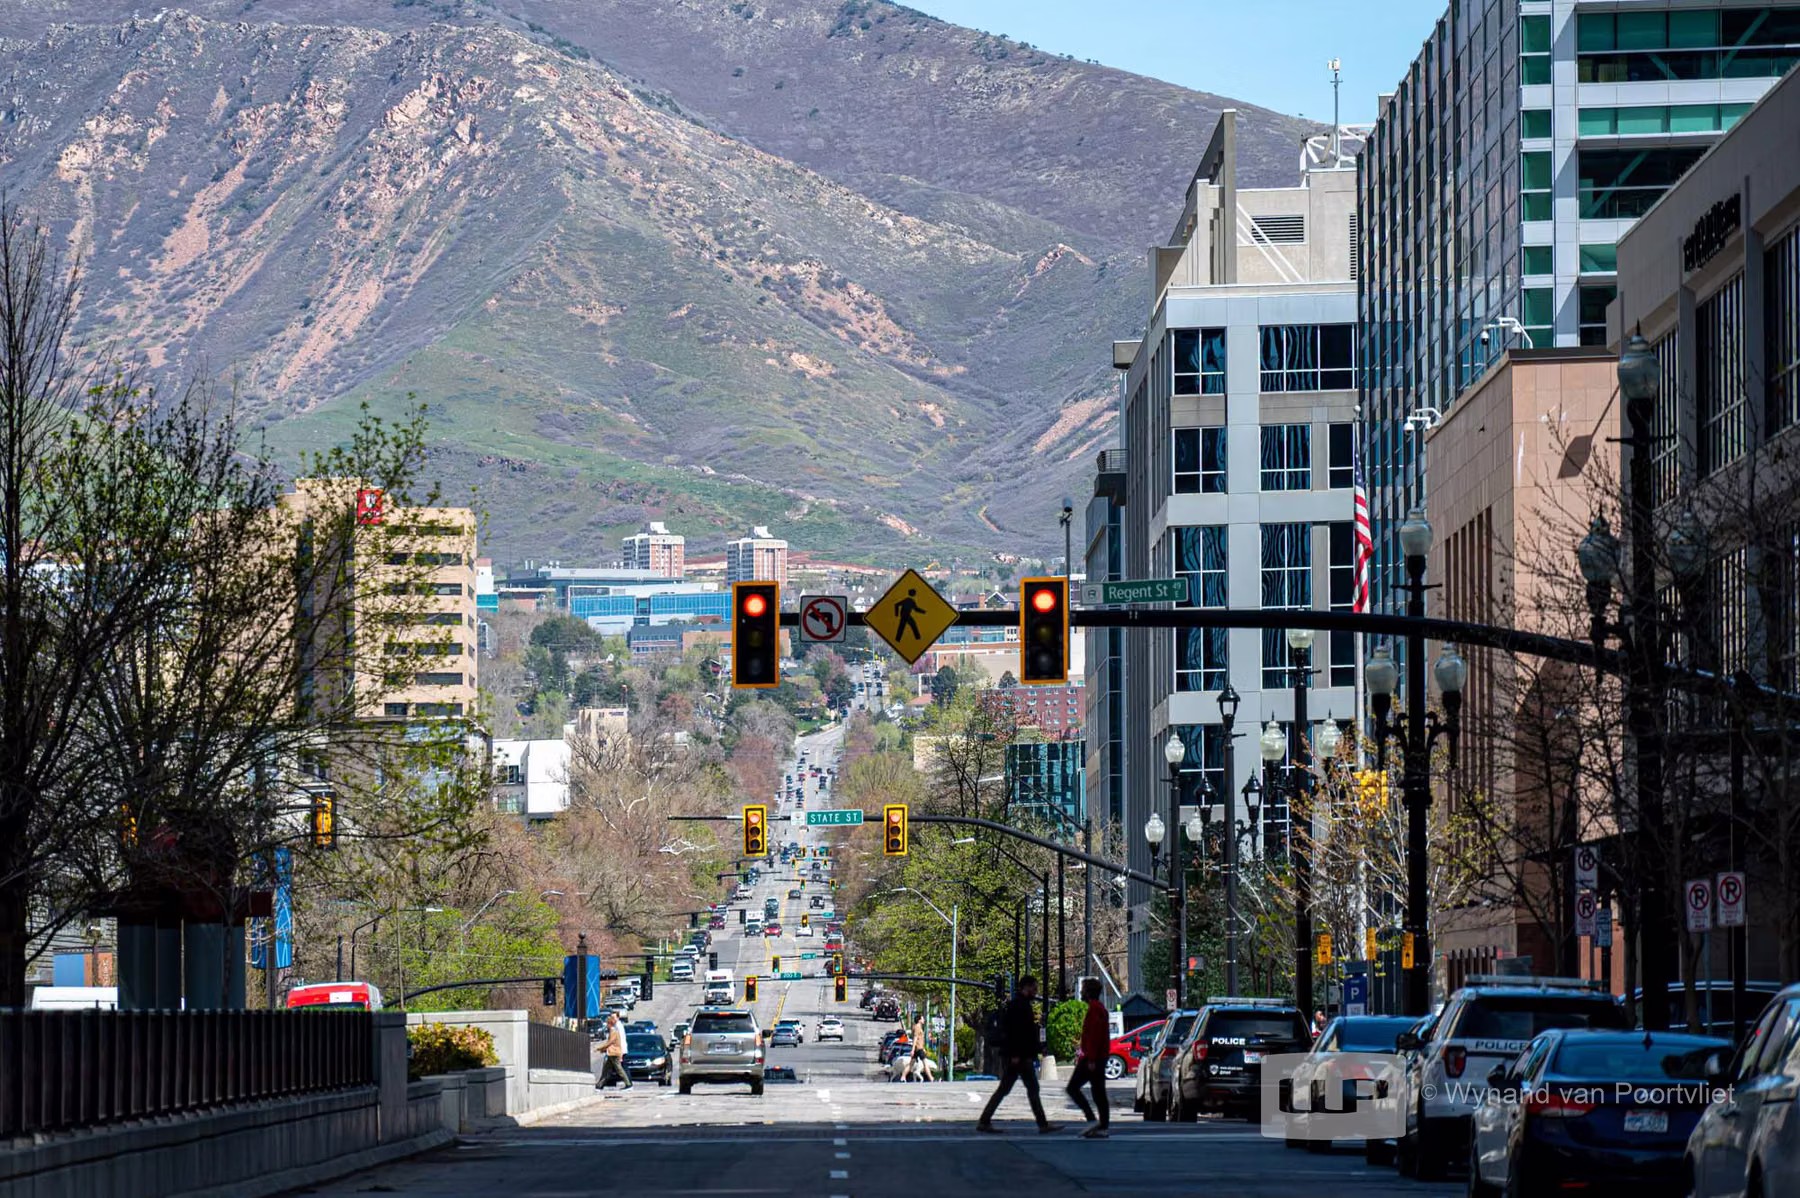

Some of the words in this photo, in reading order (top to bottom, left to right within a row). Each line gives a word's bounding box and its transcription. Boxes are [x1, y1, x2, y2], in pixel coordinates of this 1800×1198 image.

[1172, 582, 1181, 590] 49
[1109, 586, 1152, 602] Regent
[1156, 584, 1168, 597] St
[810, 813, 840, 823] STATE
[1351, 987, 1360, 1000] P
[1212, 1037, 1246, 1045] POLICE
